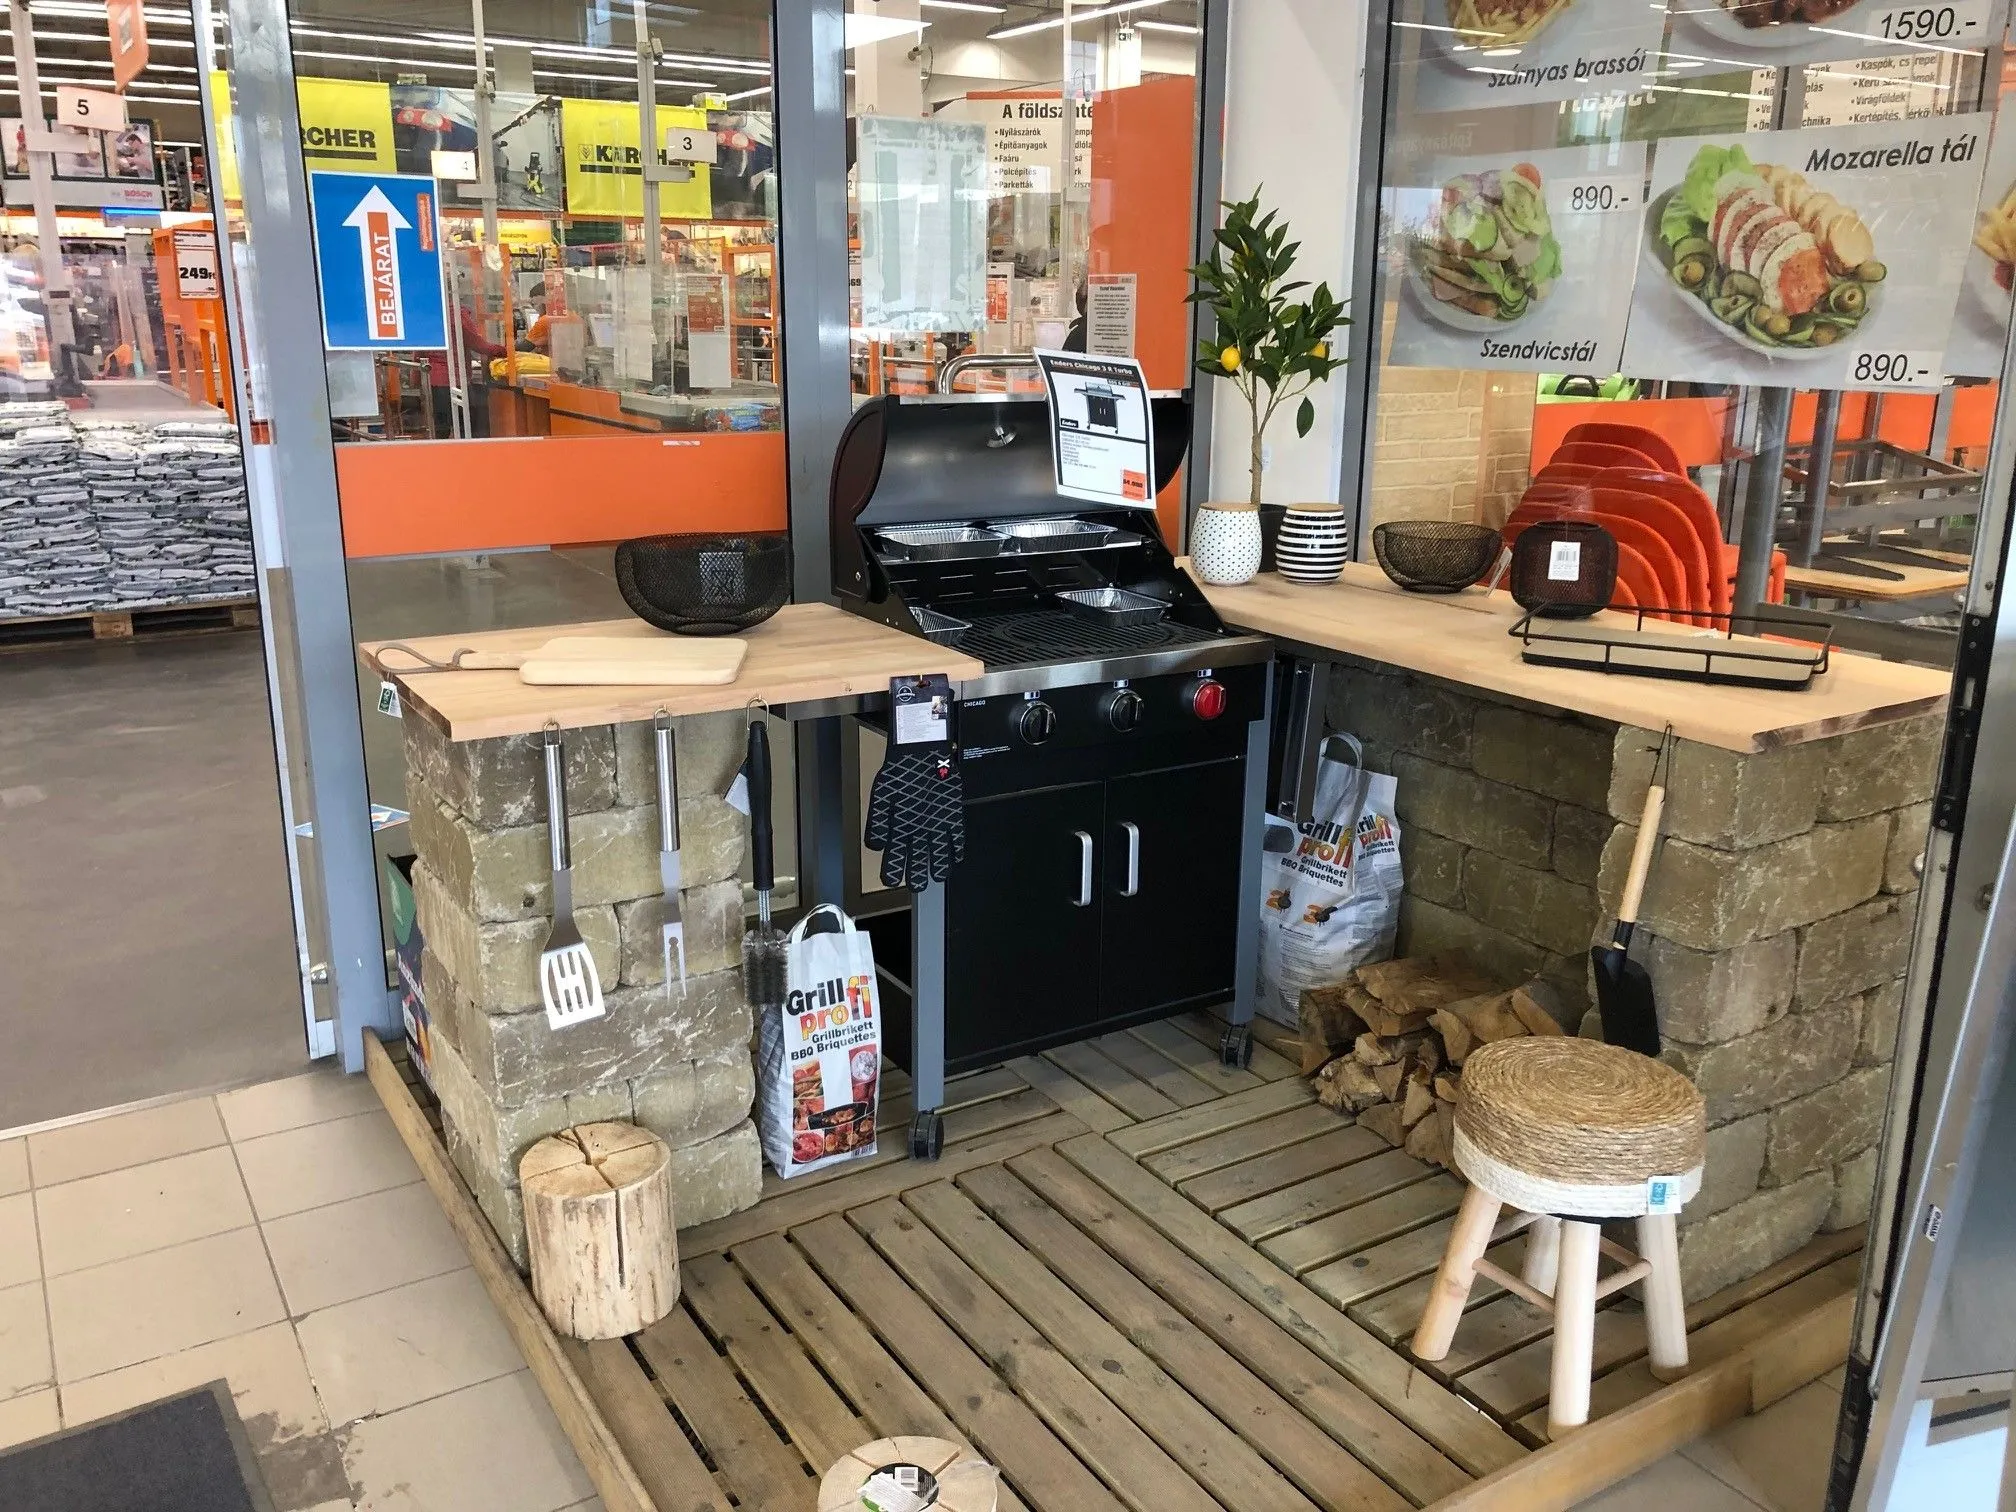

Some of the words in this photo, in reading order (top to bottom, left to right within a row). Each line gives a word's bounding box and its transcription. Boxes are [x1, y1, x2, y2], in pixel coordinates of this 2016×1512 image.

[1881, 7, 1976, 40] 1590.-
[1573, 49, 1647, 79] brassói
[76, 99, 89, 116] 5
[1002, 104, 1013, 119] A
[682, 136, 693, 151] 3
[999, 127, 1042, 138] Nyílászárók
[999, 140, 1048, 151] Építőanyagok
[999, 153, 1020, 163] Faáru
[1804, 143, 1934, 174] Mozarella
[1938, 134, 1978, 162] tál
[999, 181, 1034, 189] Parketták
[1571, 184, 1630, 211] 890.-
[374, 231, 396, 326] BEJÁRAT
[1480, 336, 1598, 364] Szendvicstál
[1074, 362, 1101, 371] Chicago
[1853, 351, 1929, 385] 890.-
[963, 700, 986, 708] CHICAGO
[1280, 856, 1298, 871] BBQ
[1298, 864, 1344, 888] Briquettes
[1300, 855, 1348, 879] Grillbrikett
[785, 977, 845, 1016] Grill
[800, 975, 872, 1041] profi
[811, 1020, 874, 1044] Grillbrikett
[790, 1046, 814, 1061] BBQ
[817, 1031, 877, 1054] Briquettes
